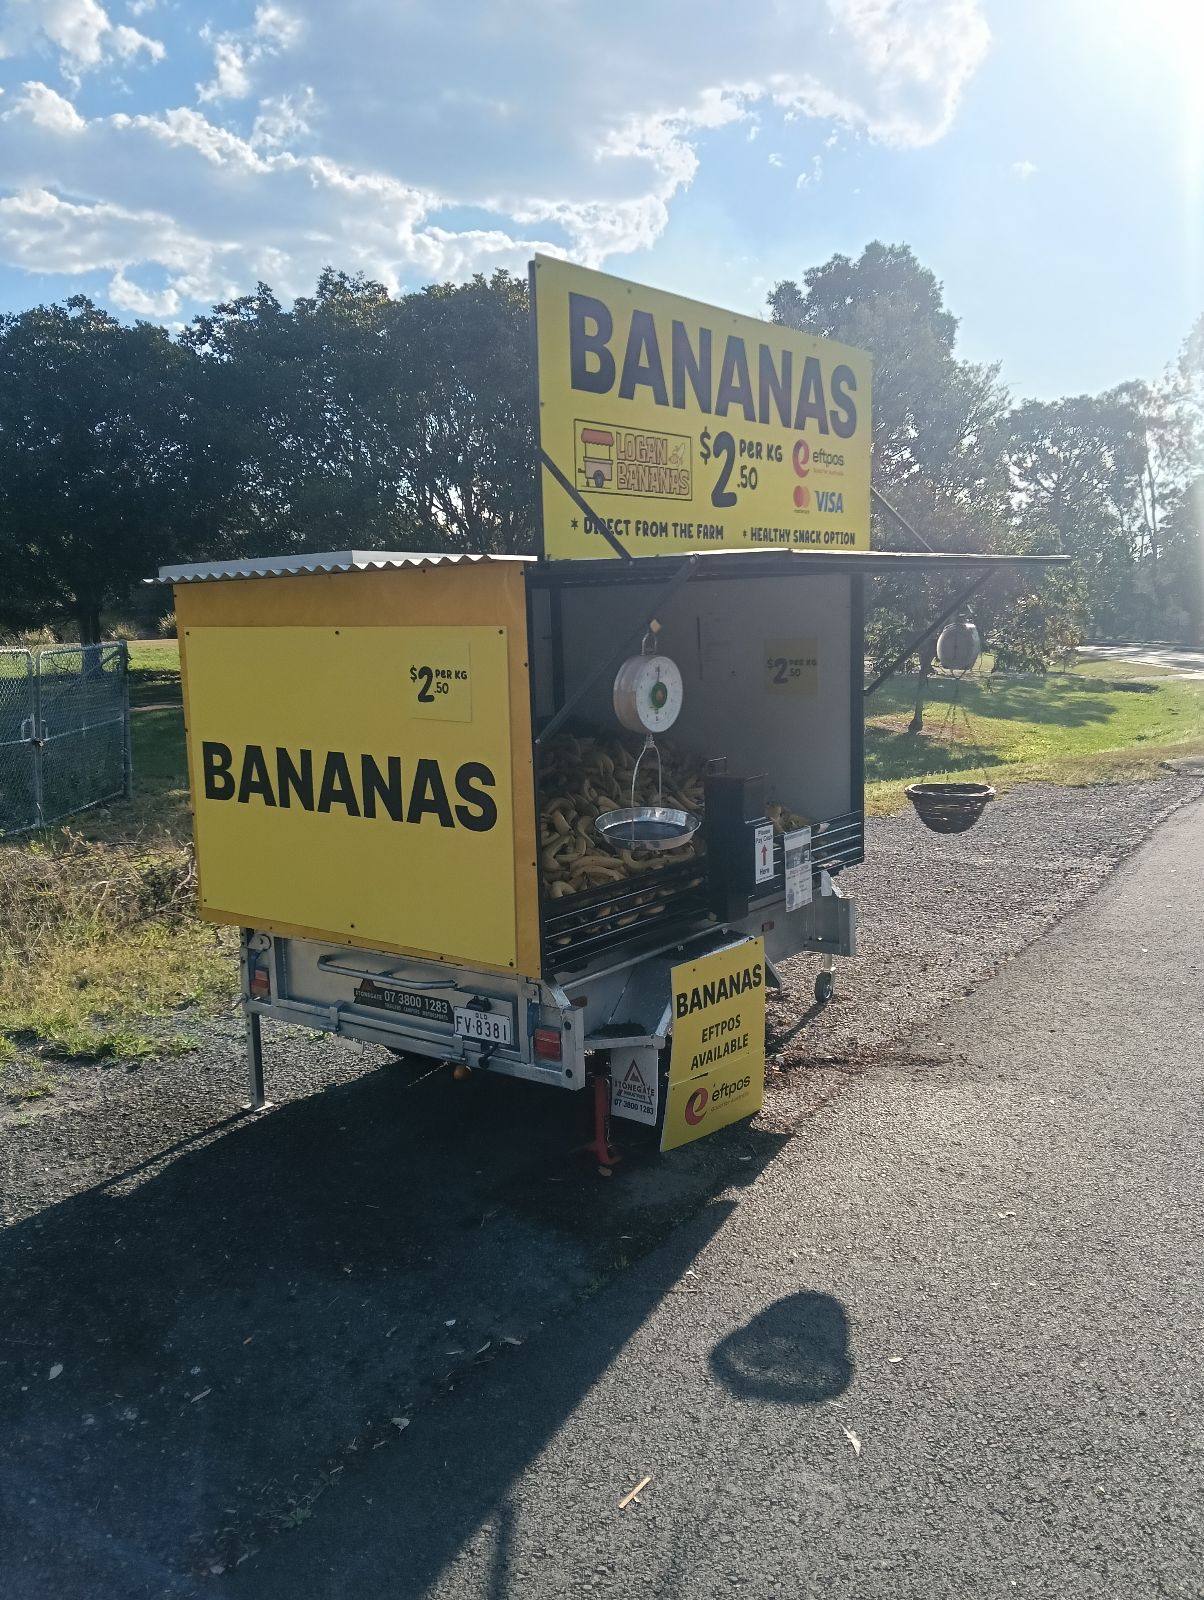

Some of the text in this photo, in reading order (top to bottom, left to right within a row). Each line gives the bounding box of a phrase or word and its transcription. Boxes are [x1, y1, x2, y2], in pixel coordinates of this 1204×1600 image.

[568, 292, 857, 438] BANANAS
[616, 431, 668, 465] LOGAN
[766, 443, 783, 463] KG
[812, 447, 845, 468] eftpos
[617, 462, 690, 496] BANANAS
[814, 490, 844, 514] VISA
[635, 520, 669, 538] FROM
[672, 522, 694, 539] THE
[696, 524, 724, 540] FARM
[750, 526, 856, 545] HEALTHY SNACK OPTION
[454, 670, 468, 681] KG
[202, 740, 498, 832] BANANAS
[384, 990, 396, 1003] 07
[398, 993, 422, 1009] 3800
[425, 998, 449, 1014] 1283
[675, 963, 762, 1019] BANANAS
[701, 1013, 742, 1044] EFTPOS
[690, 1032, 750, 1071] AVAILABLE
[614, 1080, 655, 1097] STONEGATE
[711, 1076, 751, 1102] eftpos
[614, 1098, 654, 1115] 07 3800 1283
